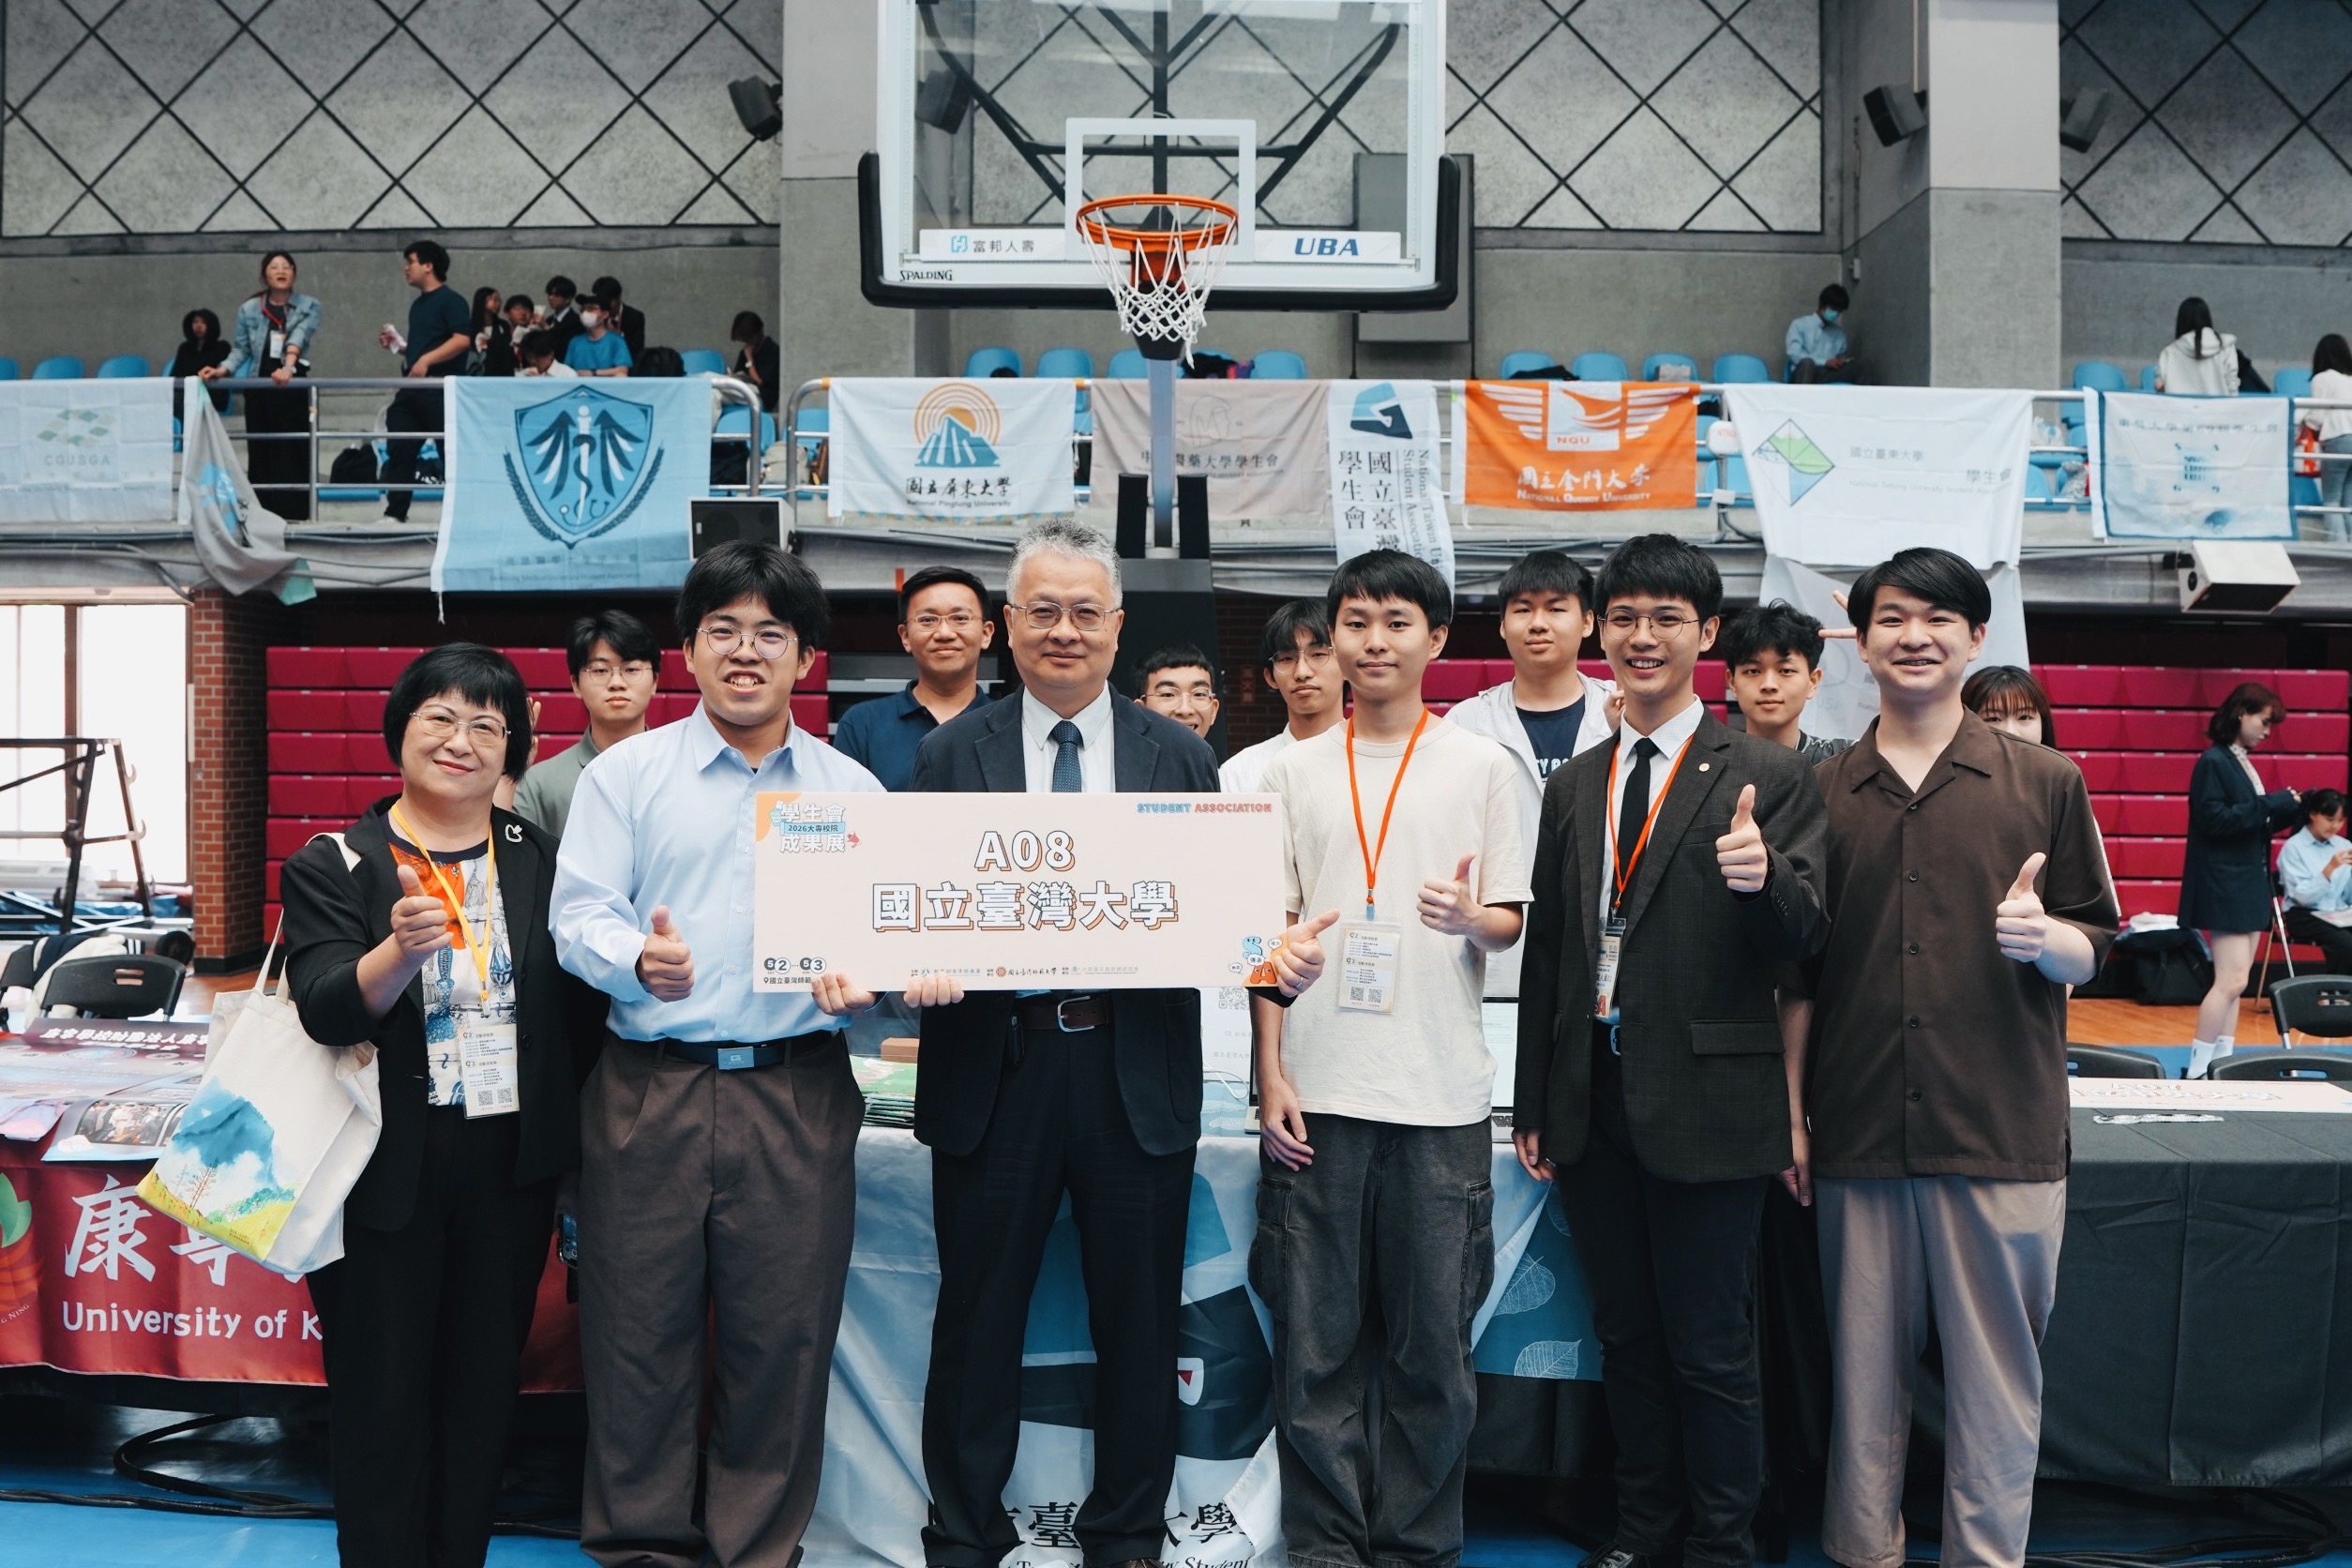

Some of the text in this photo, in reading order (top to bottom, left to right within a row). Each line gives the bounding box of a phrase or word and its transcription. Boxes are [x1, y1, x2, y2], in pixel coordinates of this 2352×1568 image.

[973, 240, 1034, 252] 富邦人壽
[1295, 238, 1358, 255] UBA
[900, 269, 953, 281] SPALDING
[1557, 436, 1591, 445] NQU
[1141, 450, 1278, 469] 中醫藥大學學生會
[1850, 446, 1923, 460] 國立臺東大學
[1403, 449, 1415, 499] Student
[1418, 449, 1430, 502] National
[1518, 463, 1651, 490] 國立金門大學
[906, 476, 1012, 498] 國立屏東大學
[1339, 450, 1364, 530] 學生會
[781, 804, 846, 822] 學生會
[1137, 803, 1273, 813] STUDENT ASSOCIATION
[788, 824, 838, 833] 2026大專校院
[780, 833, 845, 853] 成果展
[974, 831, 1076, 871] A08
[873, 881, 1179, 932] 國立臺灣大學
[63, 1301, 242, 1338] University
[254, 1309, 288, 1338] of
